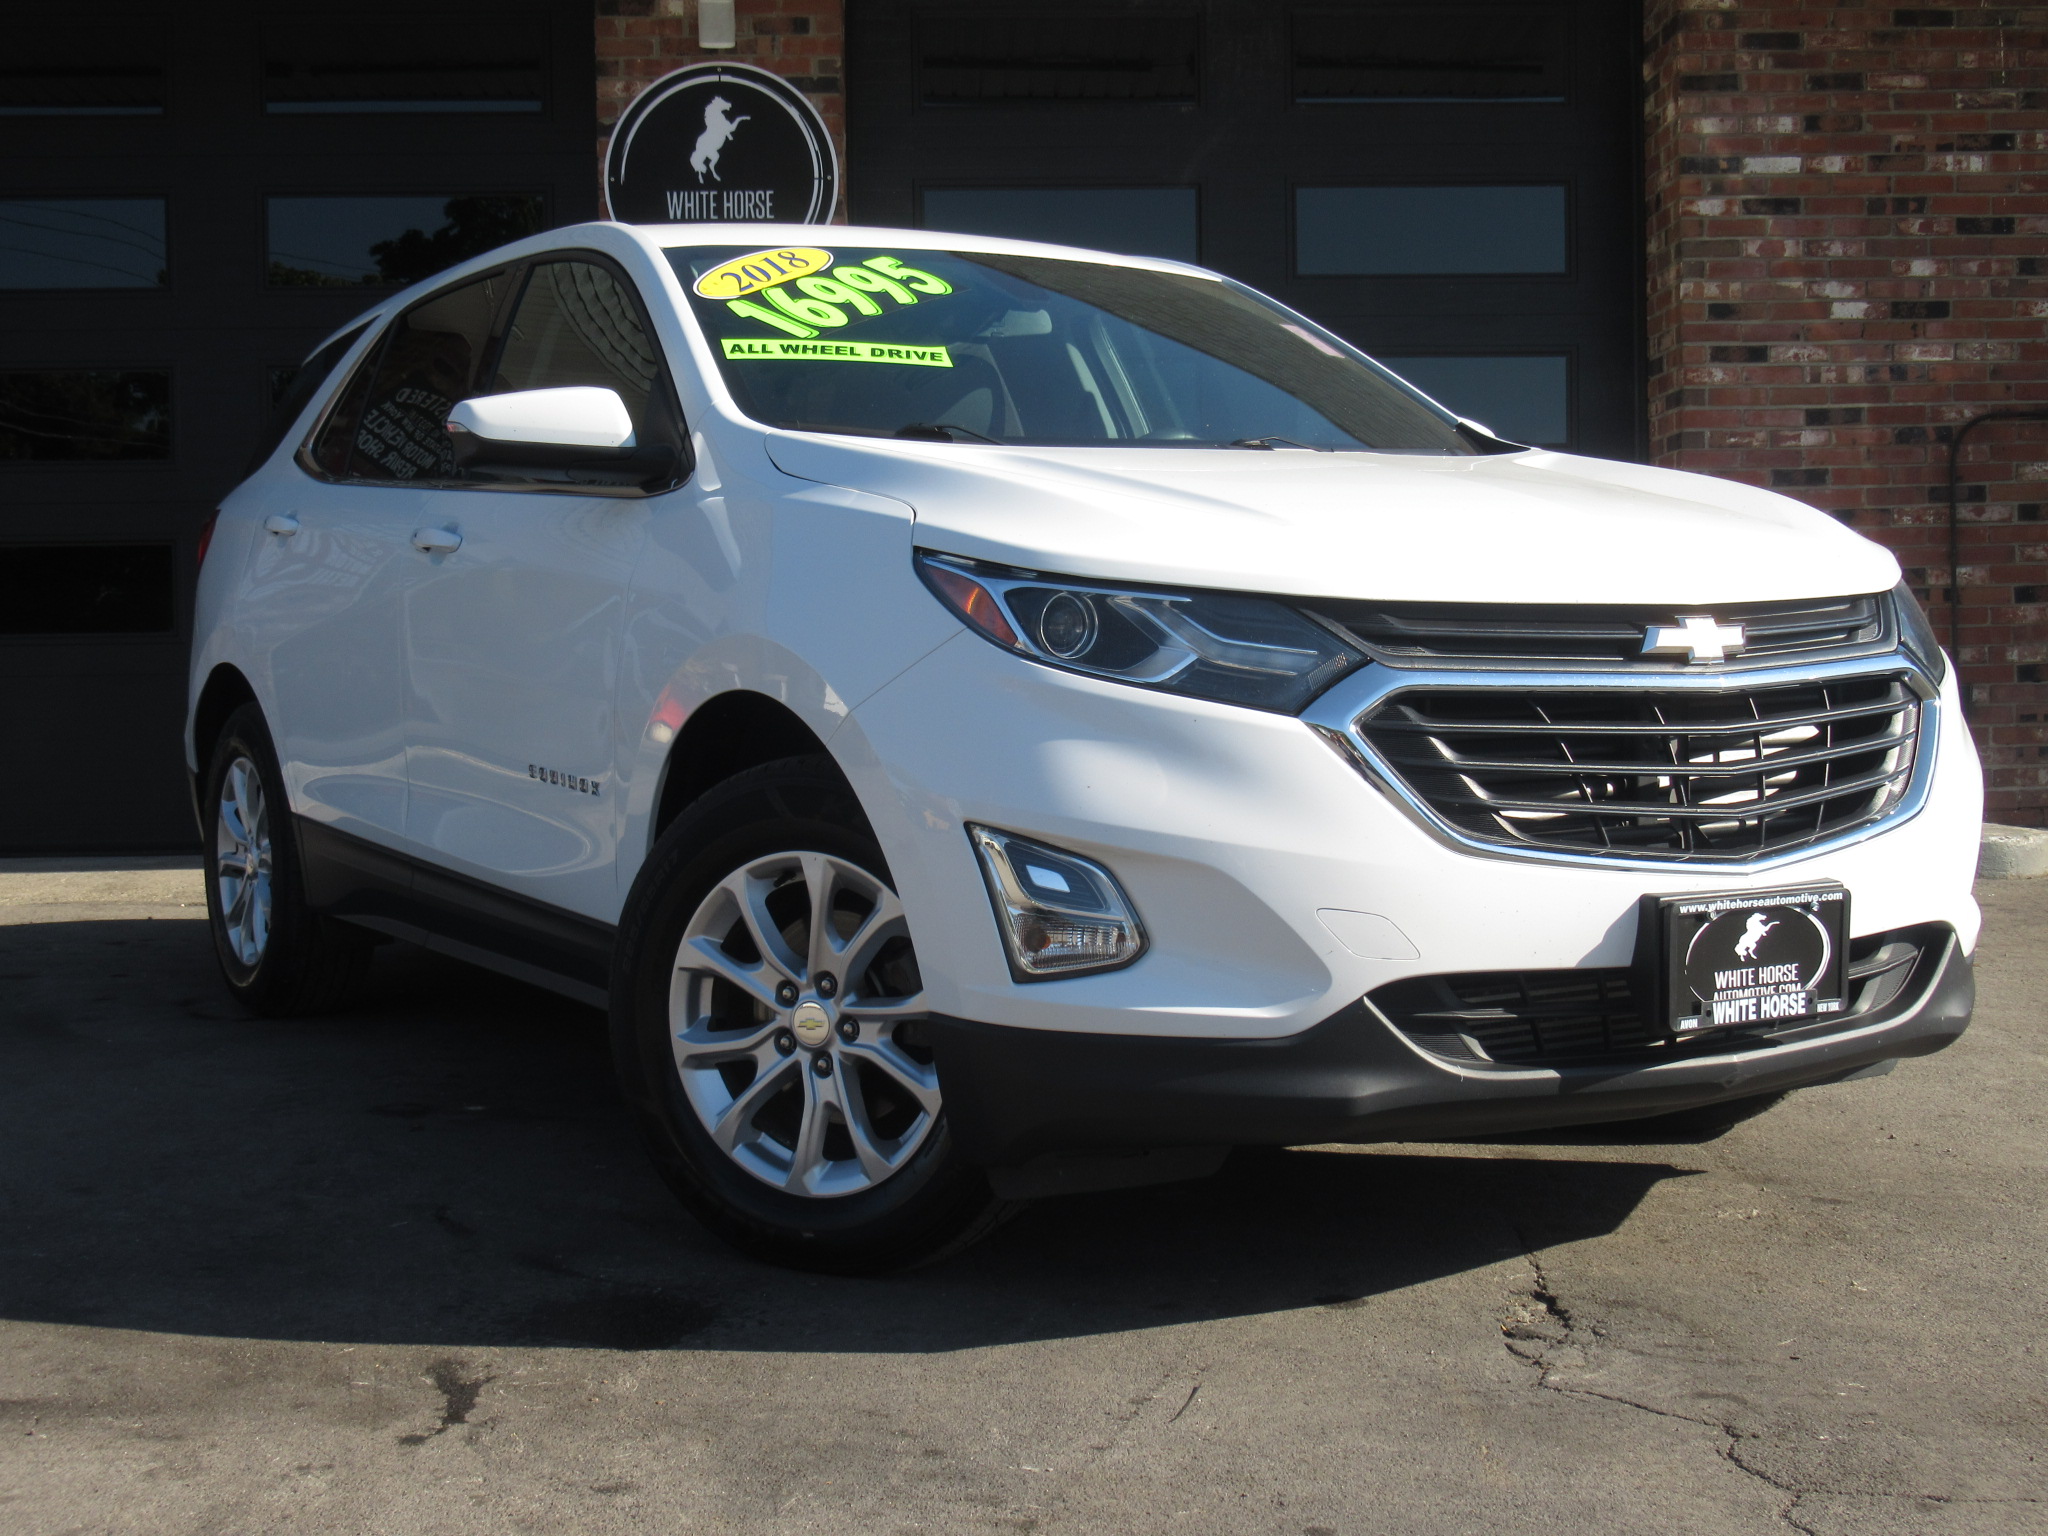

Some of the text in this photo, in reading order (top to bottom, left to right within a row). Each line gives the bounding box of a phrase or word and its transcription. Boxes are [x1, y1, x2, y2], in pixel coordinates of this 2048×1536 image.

[667, 190, 775, 220] WHITE HORSE
[720, 251, 810, 292] 2018
[726, 256, 953, 338] 16995
[730, 344, 944, 362] ALL WHEEL DRIVE
[528, 764, 600, 796] EQUINOX
[1679, 892, 1843, 914] www.whitehorseautomotive.com
[1714, 963, 1800, 990] WHITE HORSE
[1712, 992, 1806, 1025] WHITE HORSE
[1816, 1002, 1840, 1013] NEW YORK
[1680, 1018, 1698, 1030] AVON
